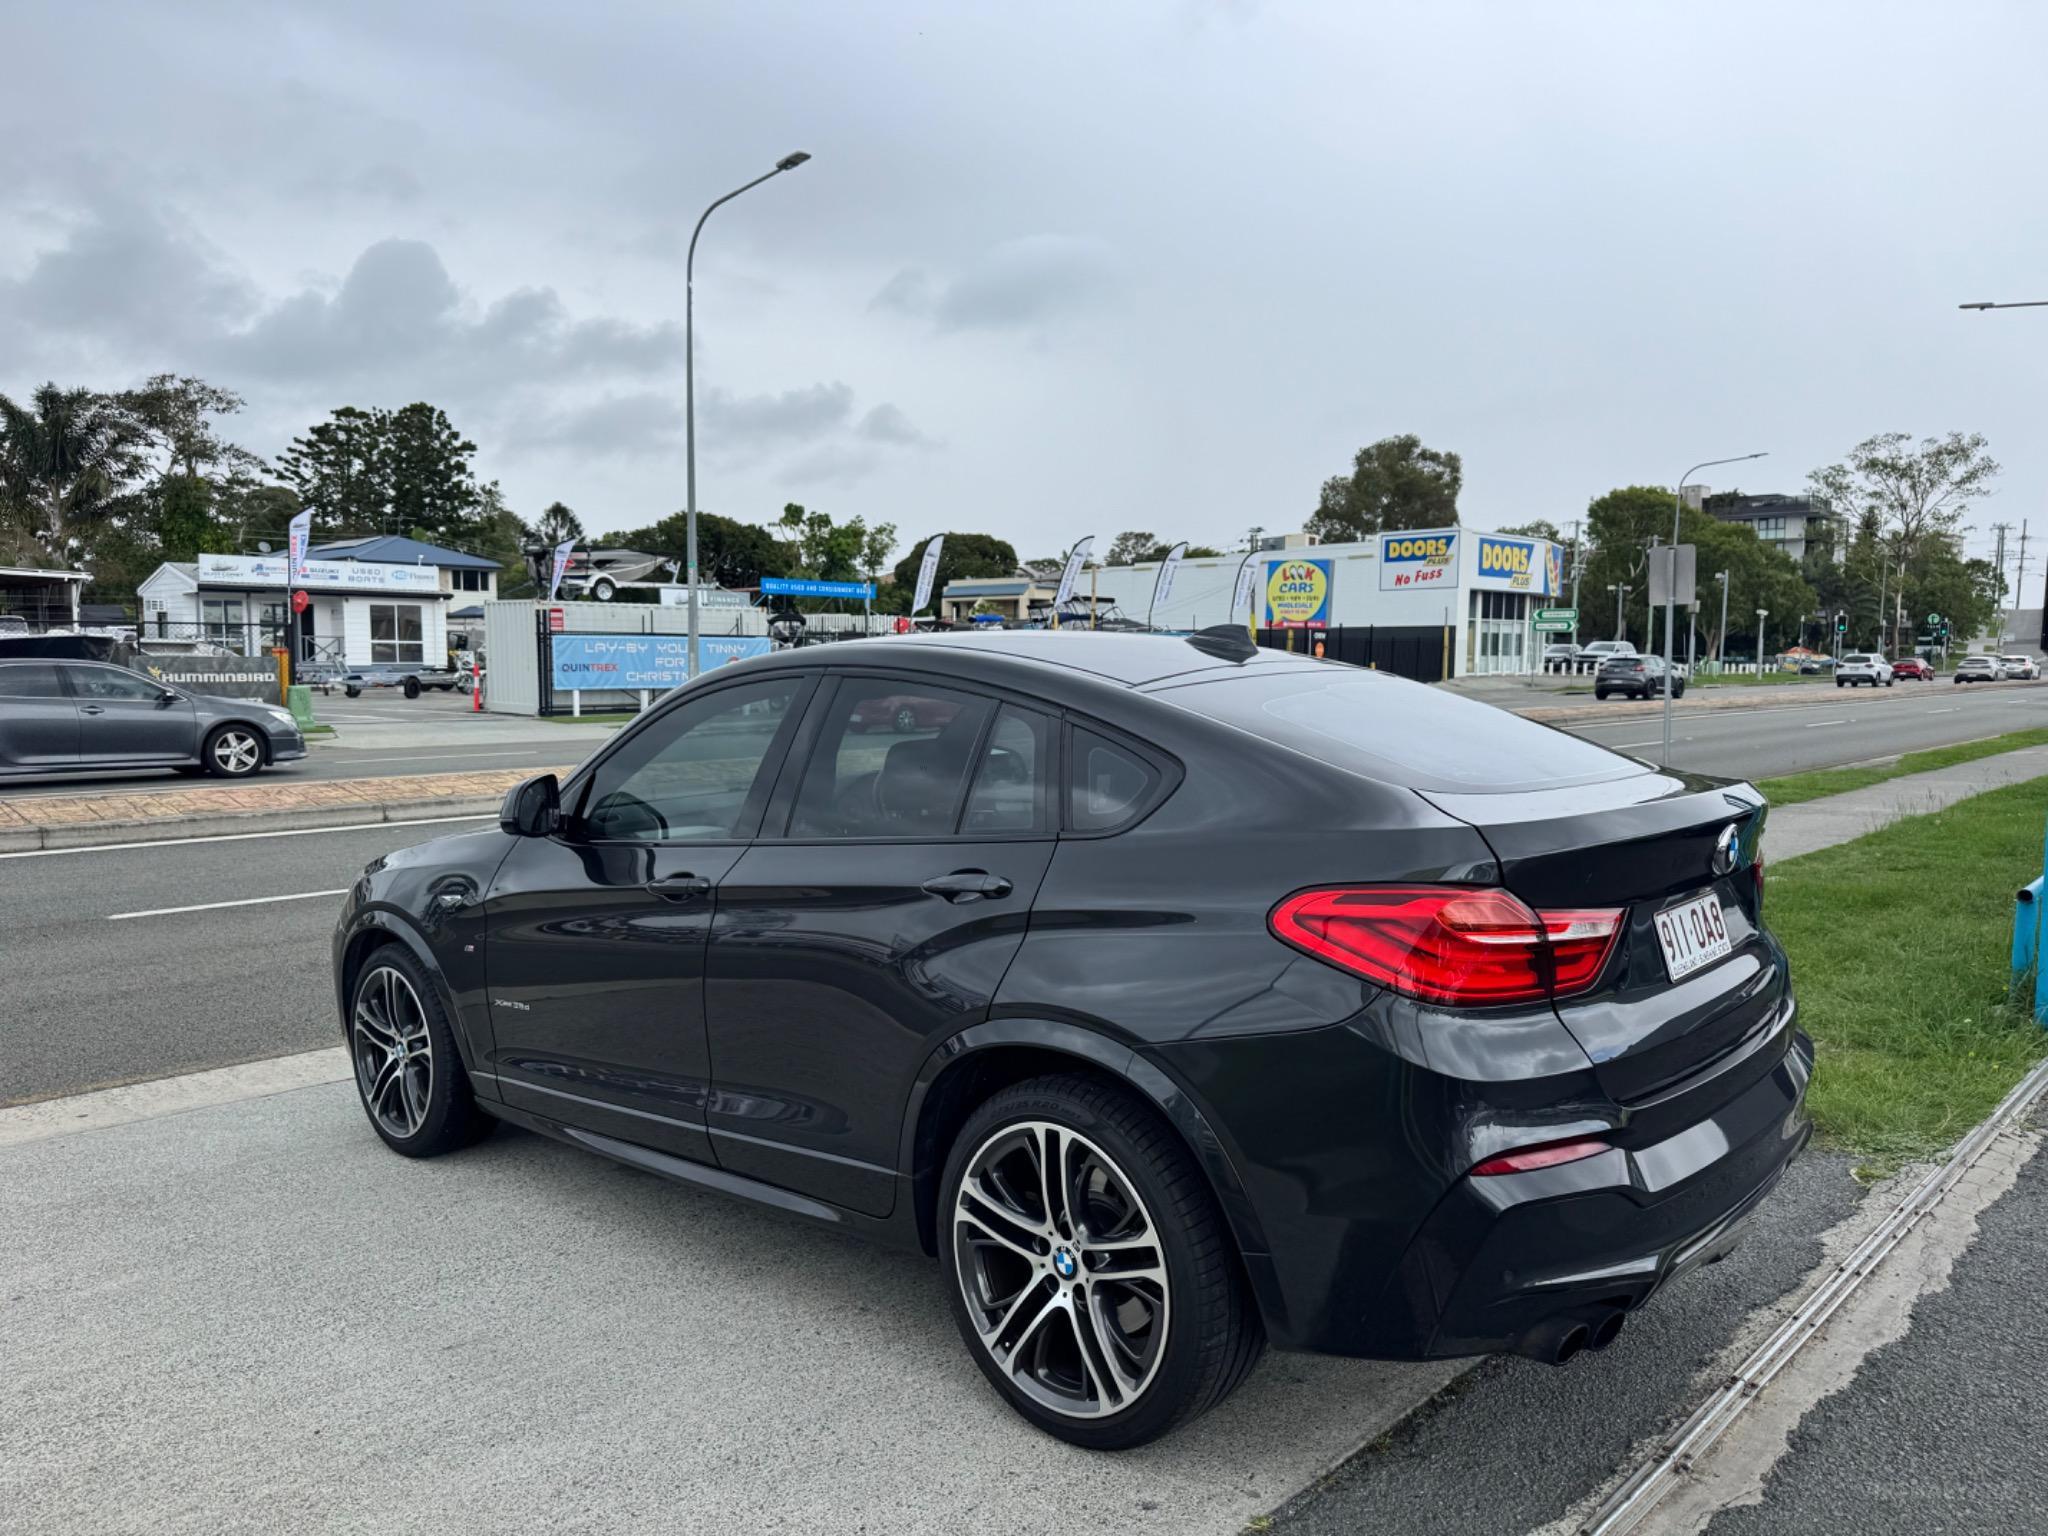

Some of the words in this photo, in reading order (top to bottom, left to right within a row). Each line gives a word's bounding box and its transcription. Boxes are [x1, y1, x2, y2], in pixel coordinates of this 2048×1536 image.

[1388, 539, 1447, 558] DOORS
[1426, 555, 1451, 565] PLUS
[1482, 543, 1529, 573] DOORS
[1282, 564, 1316, 581] LOOK
[1394, 574, 1411, 587] No
[1415, 569, 1443, 583] Fuss
[348, 576, 385, 584] BOATS
[1512, 574, 1531, 586] PLUS
[1279, 582, 1314, 593] CARS
[585, 643, 648, 653] LAY-BY
[656, 643, 689, 653] YOU
[706, 643, 747, 654] TINNY
[562, 663, 618, 673] QUINTREX
[655, 657, 685, 668] FOR
[161, 672, 277, 683] HUMMINBIRD
